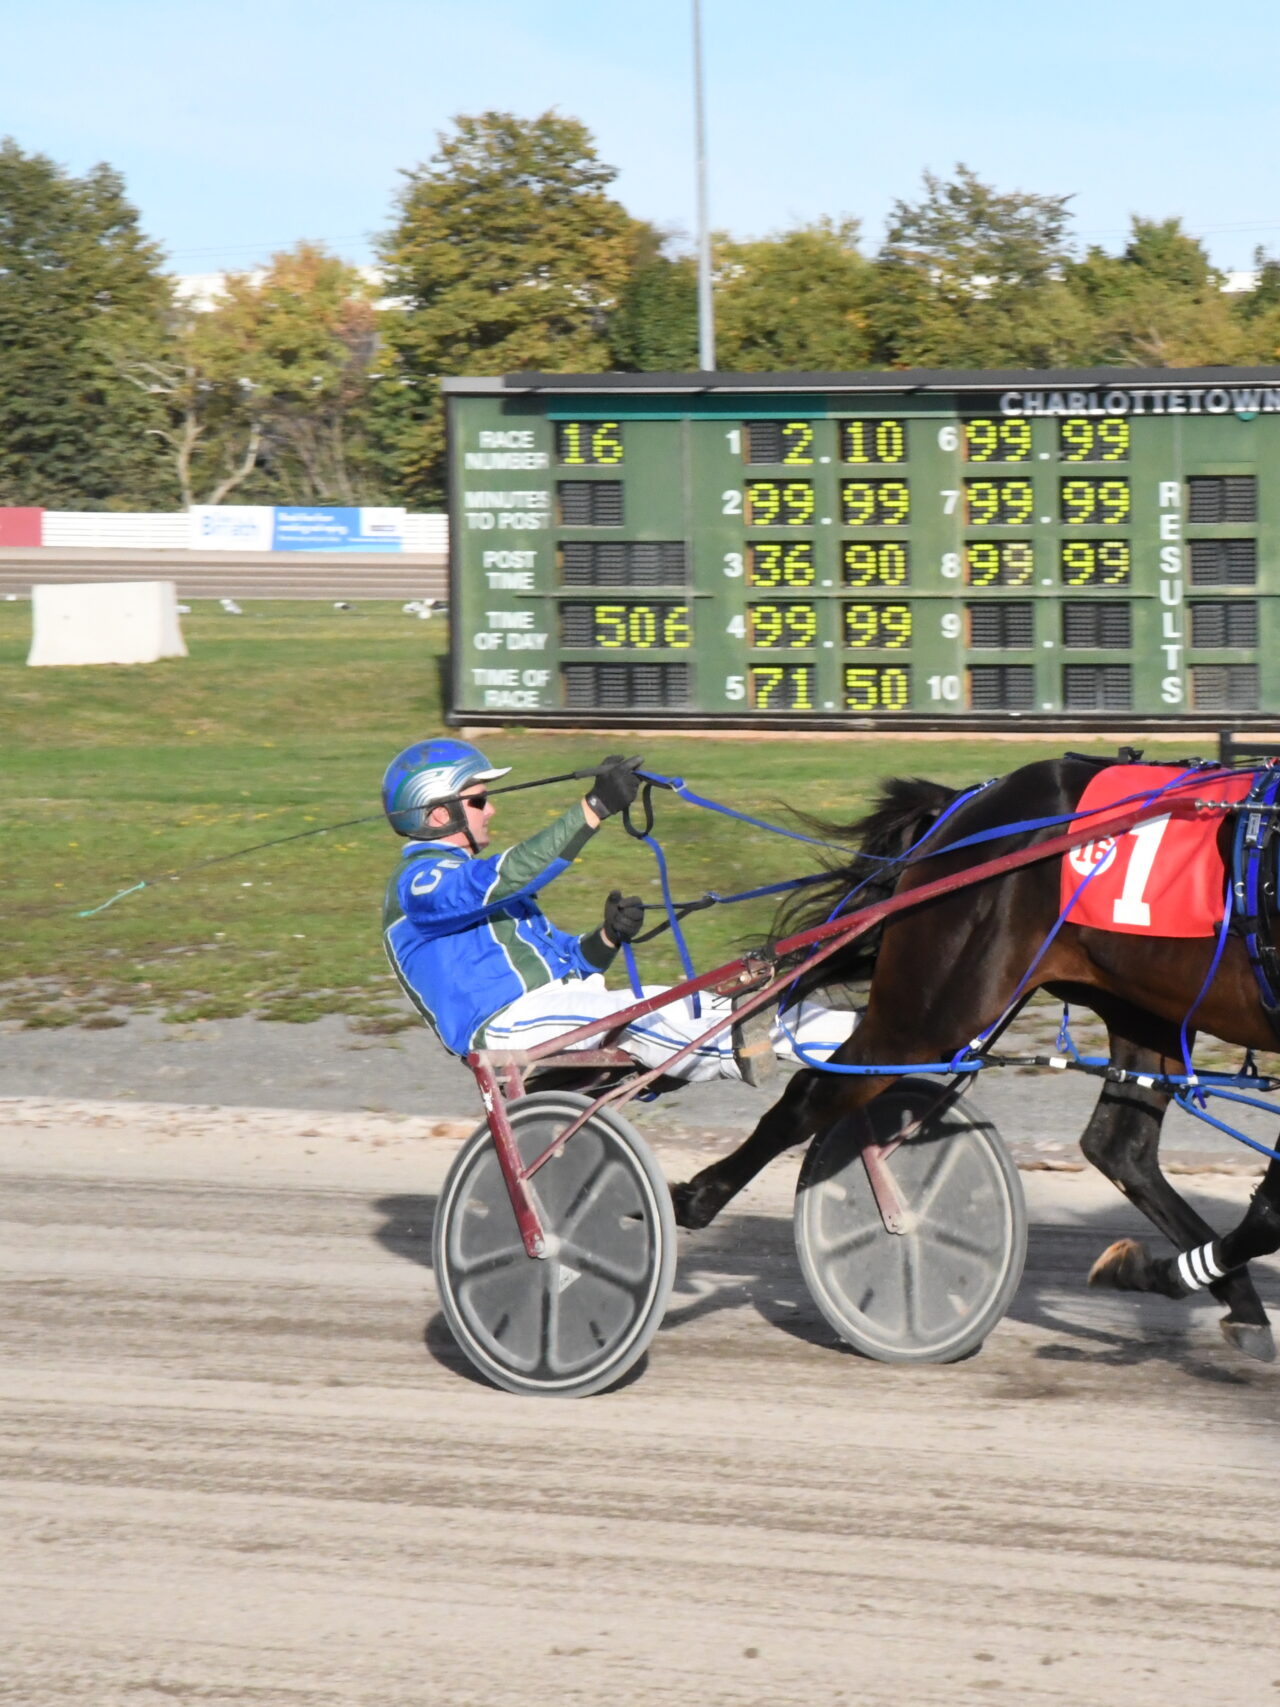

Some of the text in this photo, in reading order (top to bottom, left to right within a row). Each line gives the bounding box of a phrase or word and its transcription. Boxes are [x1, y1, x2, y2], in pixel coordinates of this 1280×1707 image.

[479, 431, 535, 448] RACE
[564, 422, 623, 463] 16
[726, 430, 741, 454] 1
[938, 427, 959, 452] 6
[465, 452, 550, 470] NUMBER
[464, 491, 550, 508] MINUTES
[721, 490, 743, 515] 2
[939, 490, 961, 515] 7
[465, 512, 551, 530] TO POST
[482, 551, 537, 568] POST
[723, 553, 744, 577] 3
[940, 552, 962, 578] 8
[486, 572, 535, 589] TIME
[1158, 480, 1184, 704] RESULTS
[485, 611, 535, 629] TIME
[595, 606, 693, 648] 506
[726, 615, 747, 639] 4
[940, 613, 962, 638] 9
[474, 632, 548, 650] OF DAY
[471, 669, 551, 687] TIME OF
[726, 676, 746, 700] 5
[927, 675, 961, 701] 10
[484, 690, 541, 708] RACE
[1112, 812, 1172, 927] 1
